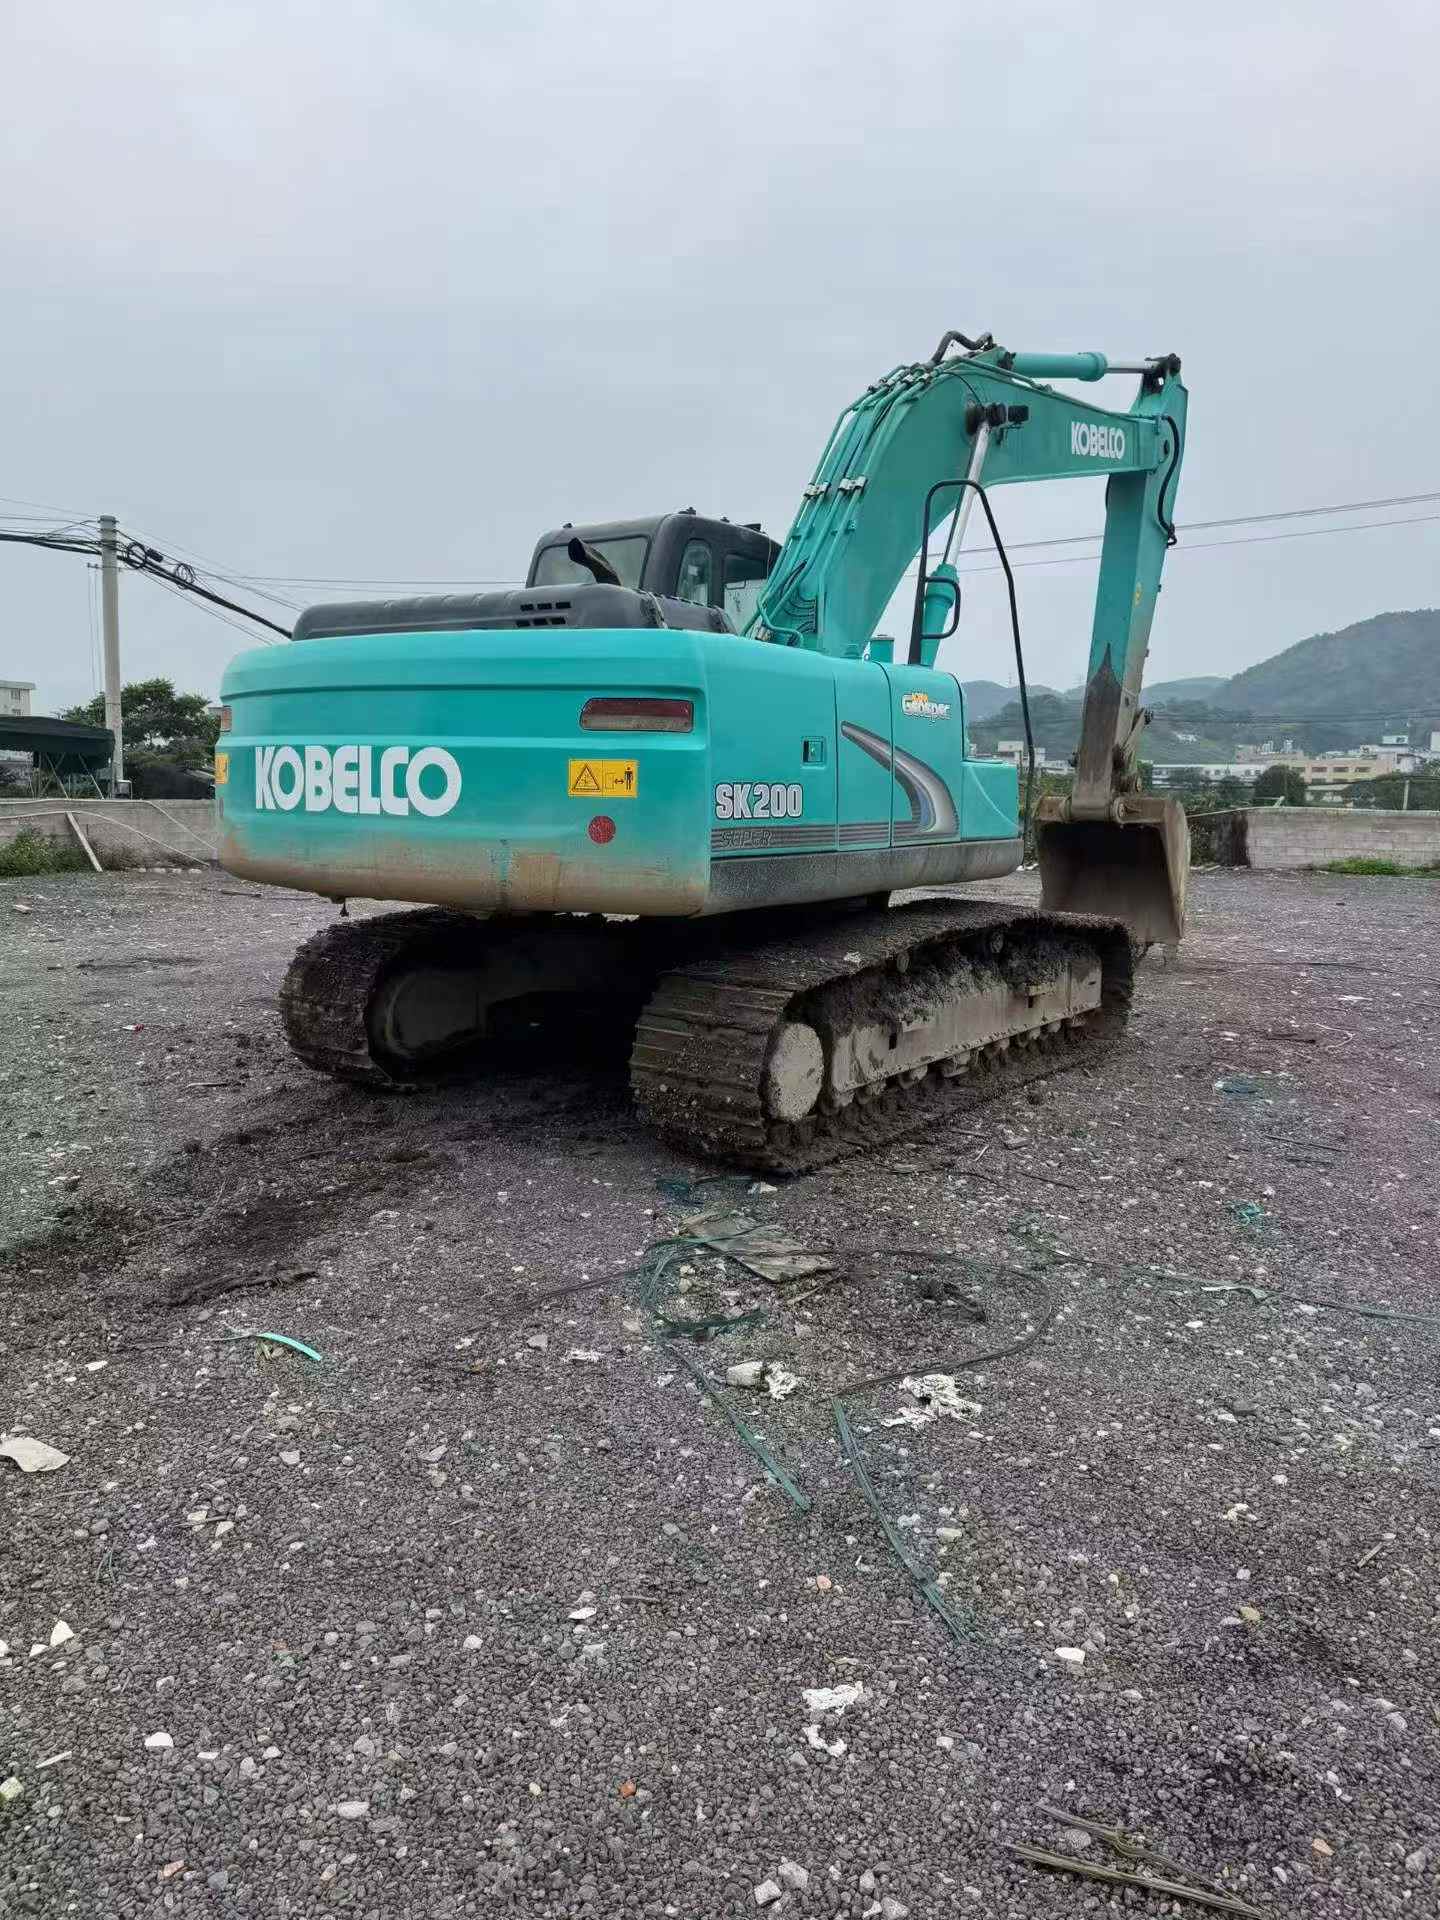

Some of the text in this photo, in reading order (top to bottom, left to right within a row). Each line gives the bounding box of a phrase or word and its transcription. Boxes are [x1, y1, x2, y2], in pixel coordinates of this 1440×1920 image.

[1071, 421, 1125, 460] KOBELCO
[255, 745, 462, 817] KOBELCO
[715, 782, 804, 819] SK200
